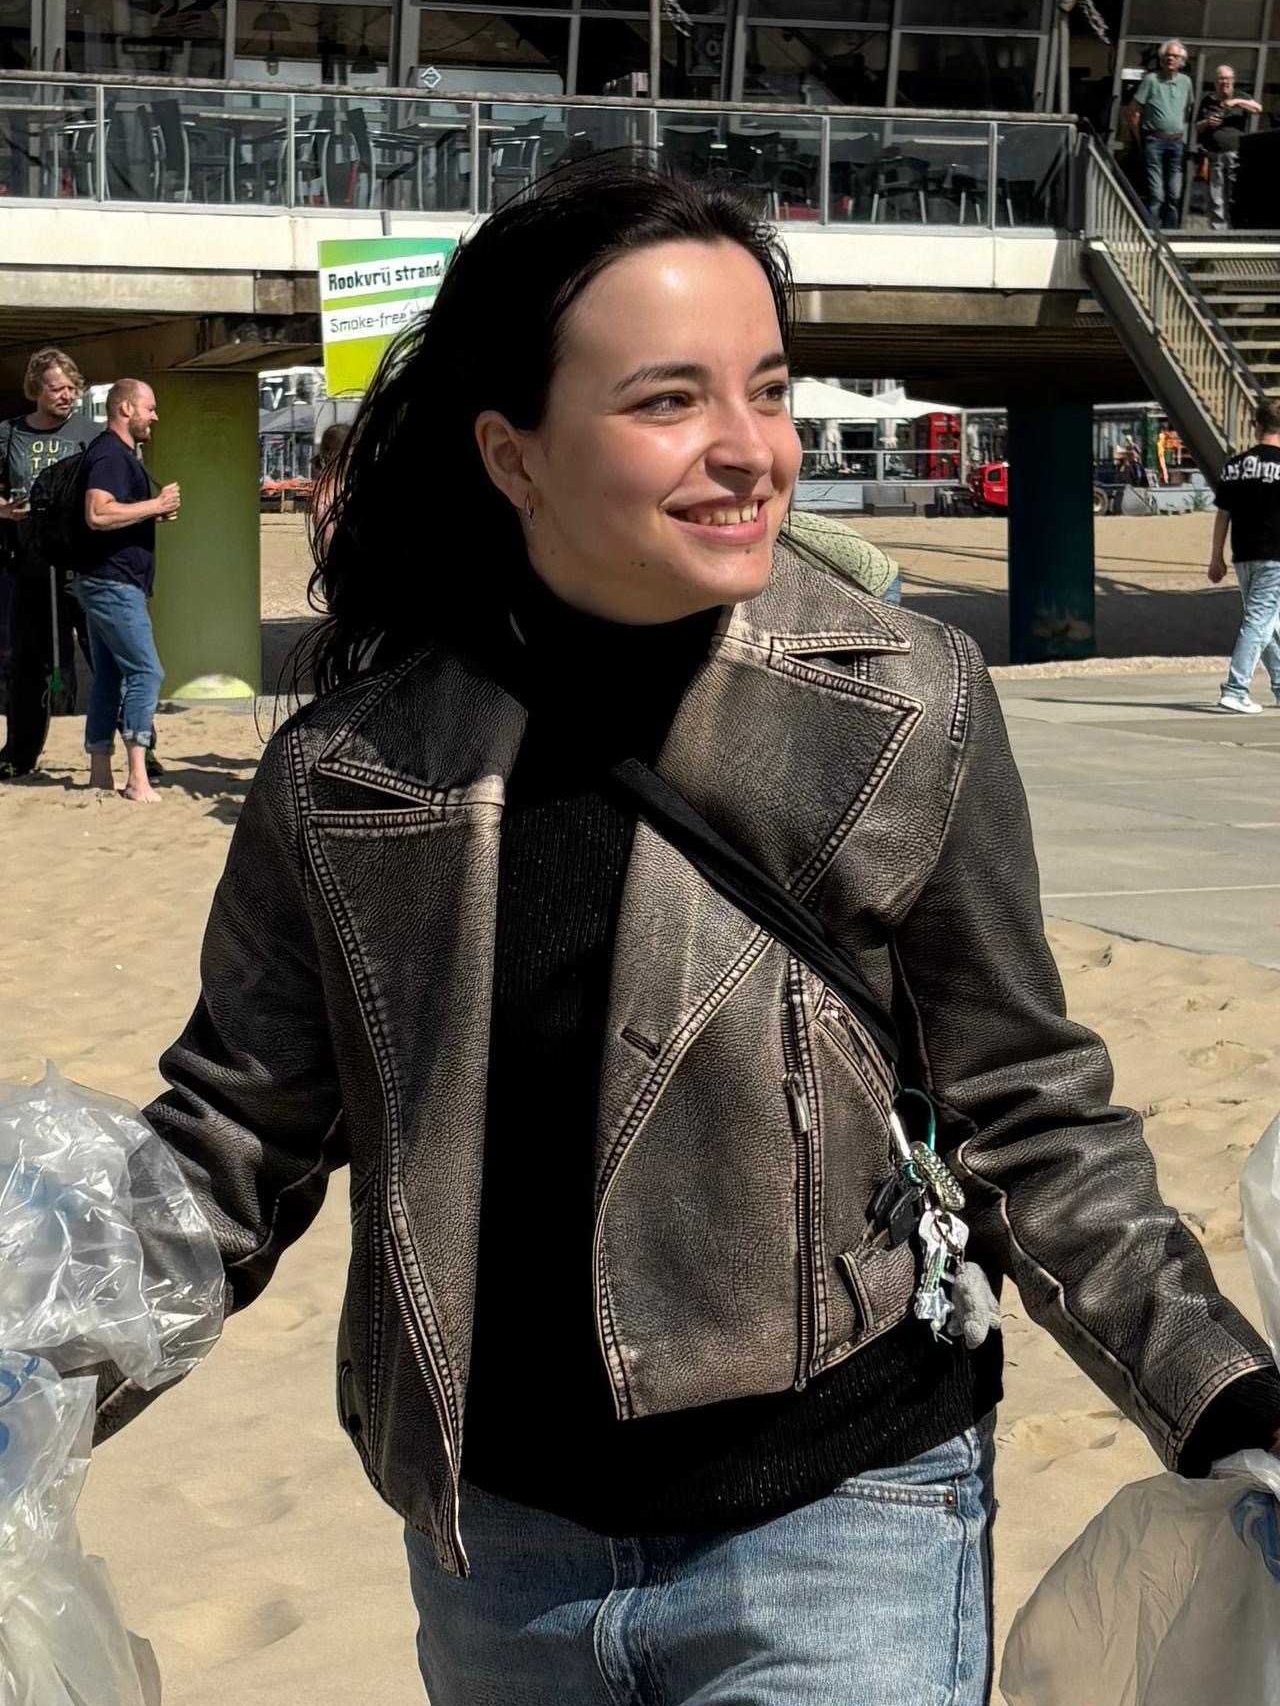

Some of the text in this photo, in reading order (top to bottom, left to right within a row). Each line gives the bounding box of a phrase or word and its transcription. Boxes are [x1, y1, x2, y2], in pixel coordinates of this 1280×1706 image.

[328, 260, 441, 291] Rookvrij strand
[330, 311, 409, 334] Smoke-free
